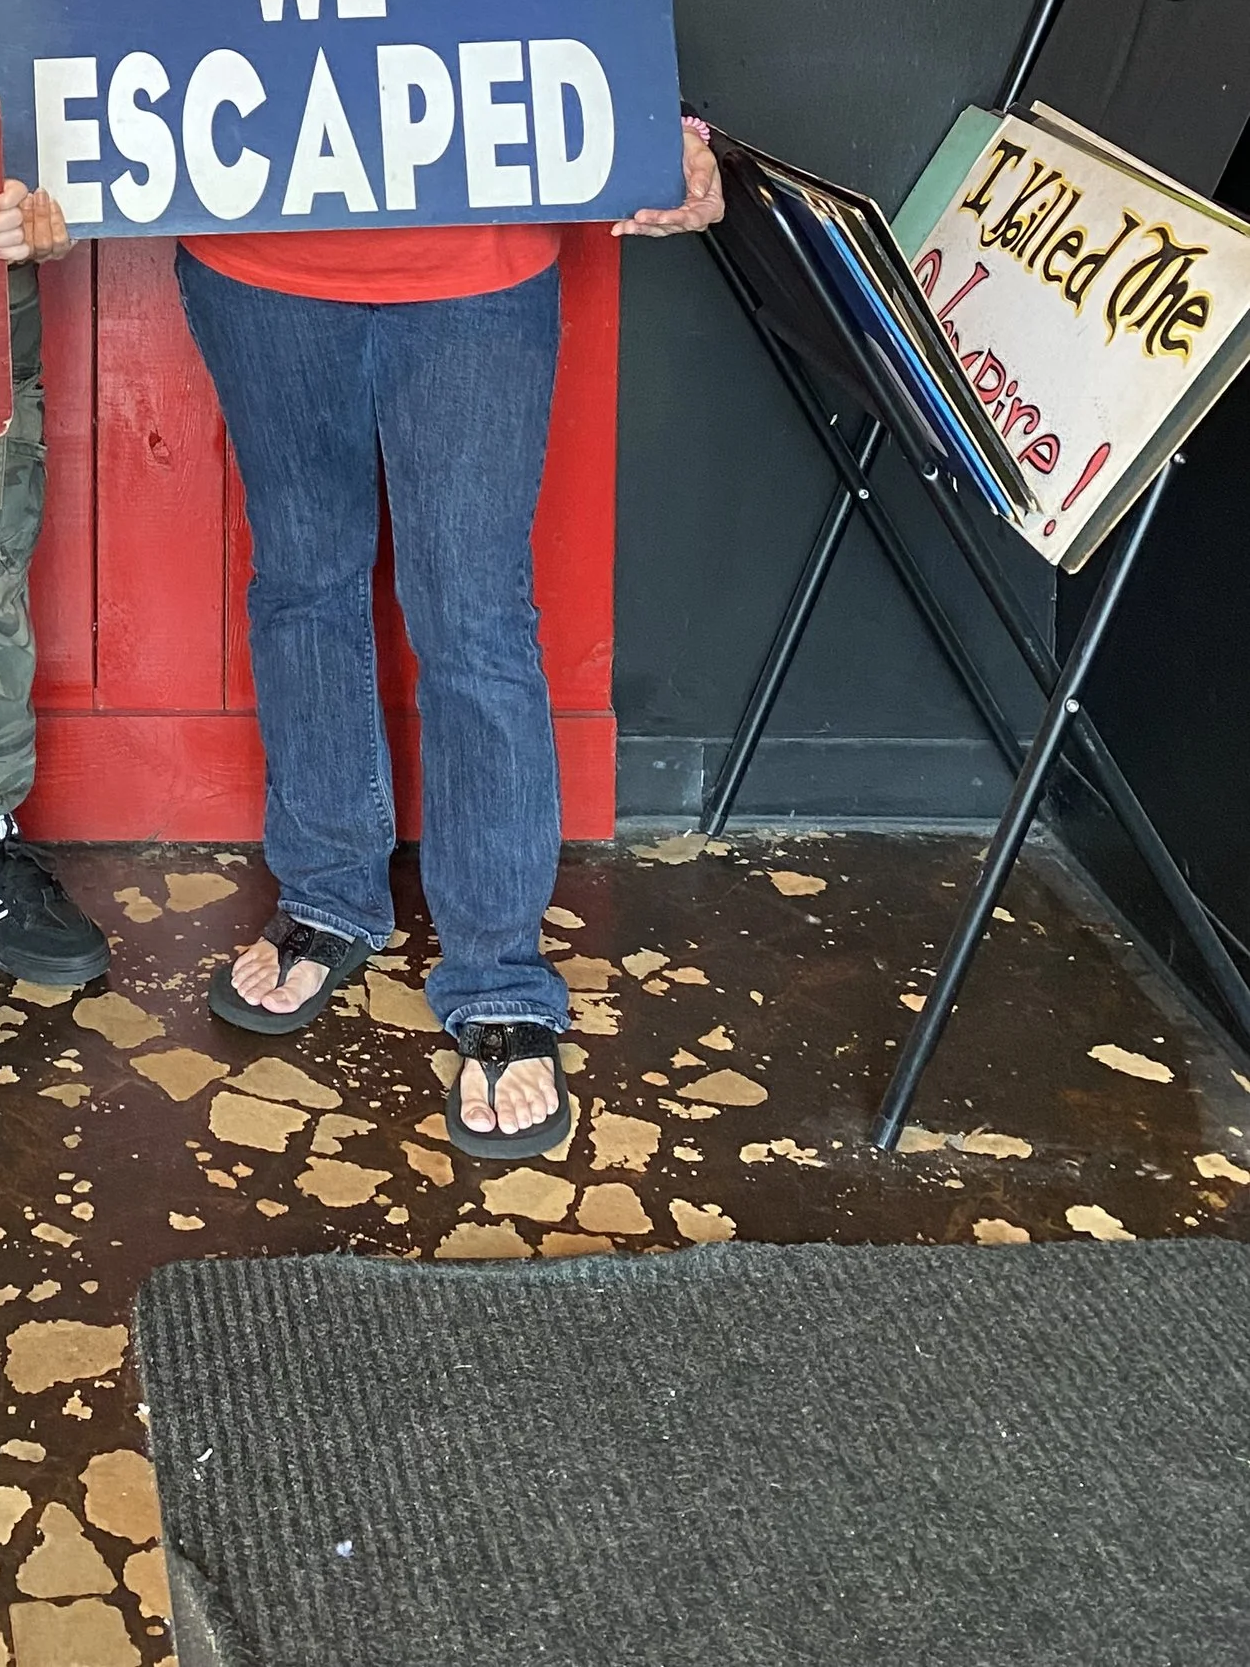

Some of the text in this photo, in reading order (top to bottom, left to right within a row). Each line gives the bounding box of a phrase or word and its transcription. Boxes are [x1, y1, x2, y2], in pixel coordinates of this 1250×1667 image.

[33, 38, 615, 224] ESCAPED
[959, 138, 1213, 368] I Killed The
[912, 248, 1112, 537] pire!
